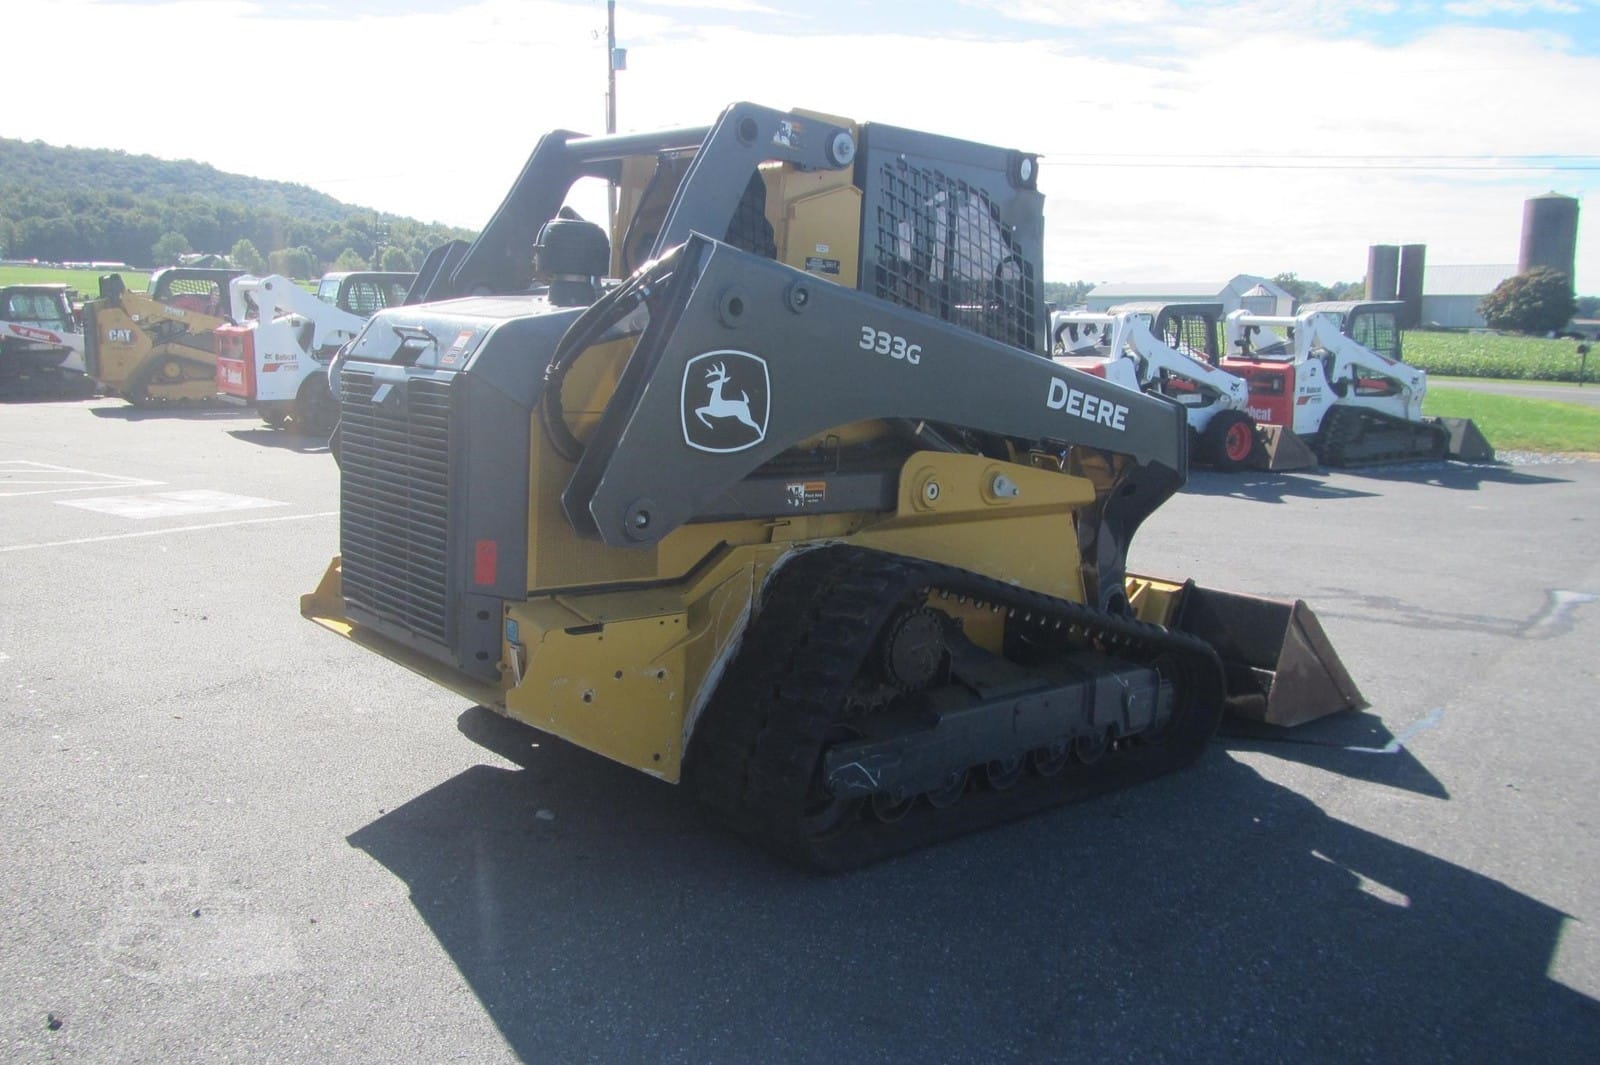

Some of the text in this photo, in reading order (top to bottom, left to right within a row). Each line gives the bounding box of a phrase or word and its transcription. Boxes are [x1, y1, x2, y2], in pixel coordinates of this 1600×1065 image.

[108, 328, 131, 342] CAT
[859, 326, 922, 365] 333G
[1046, 376, 1129, 431] DEERE
[1247, 405, 1272, 422] bcat
